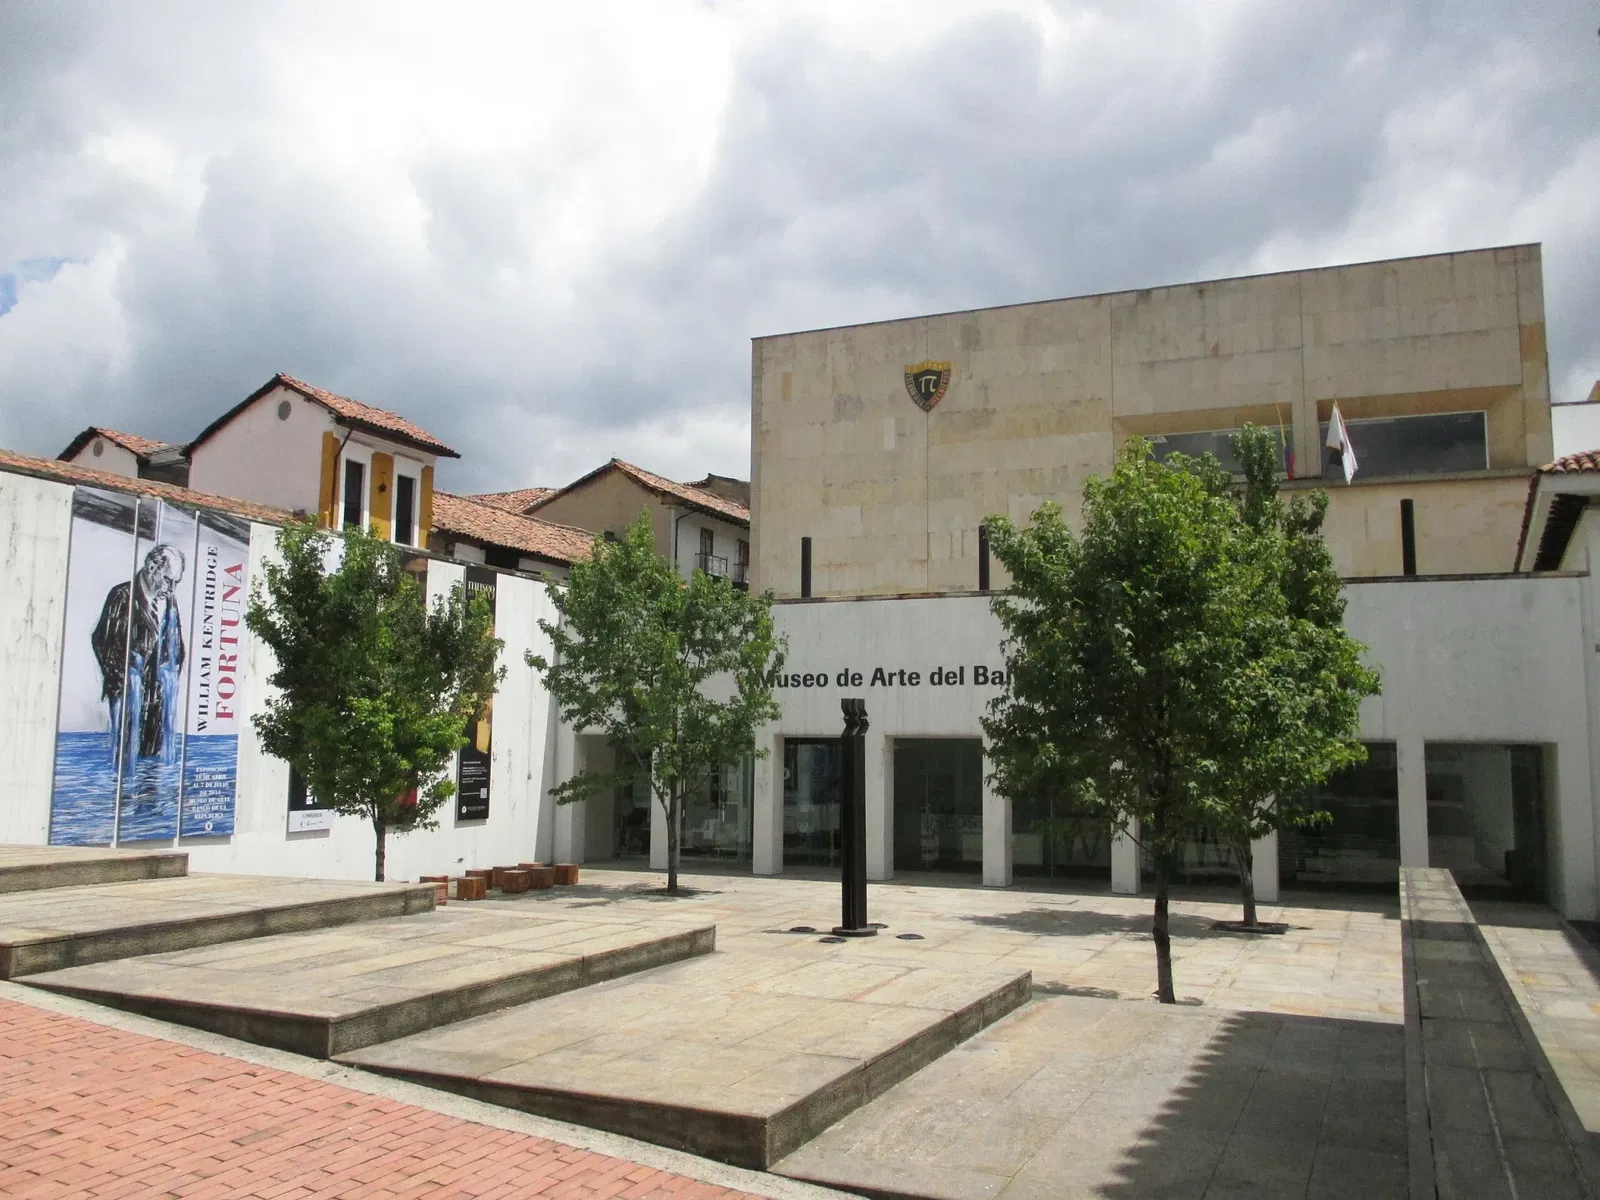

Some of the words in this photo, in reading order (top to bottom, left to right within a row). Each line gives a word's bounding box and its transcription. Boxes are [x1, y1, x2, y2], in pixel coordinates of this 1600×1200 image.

[202, 546, 219, 649] KENTRIDGE
[215, 562, 243, 721] FORTUNA
[197, 657, 212, 732] WILLIAM
[836, 667, 863, 687] de
[870, 667, 921, 687] Arte
[929, 666, 964, 686] del
